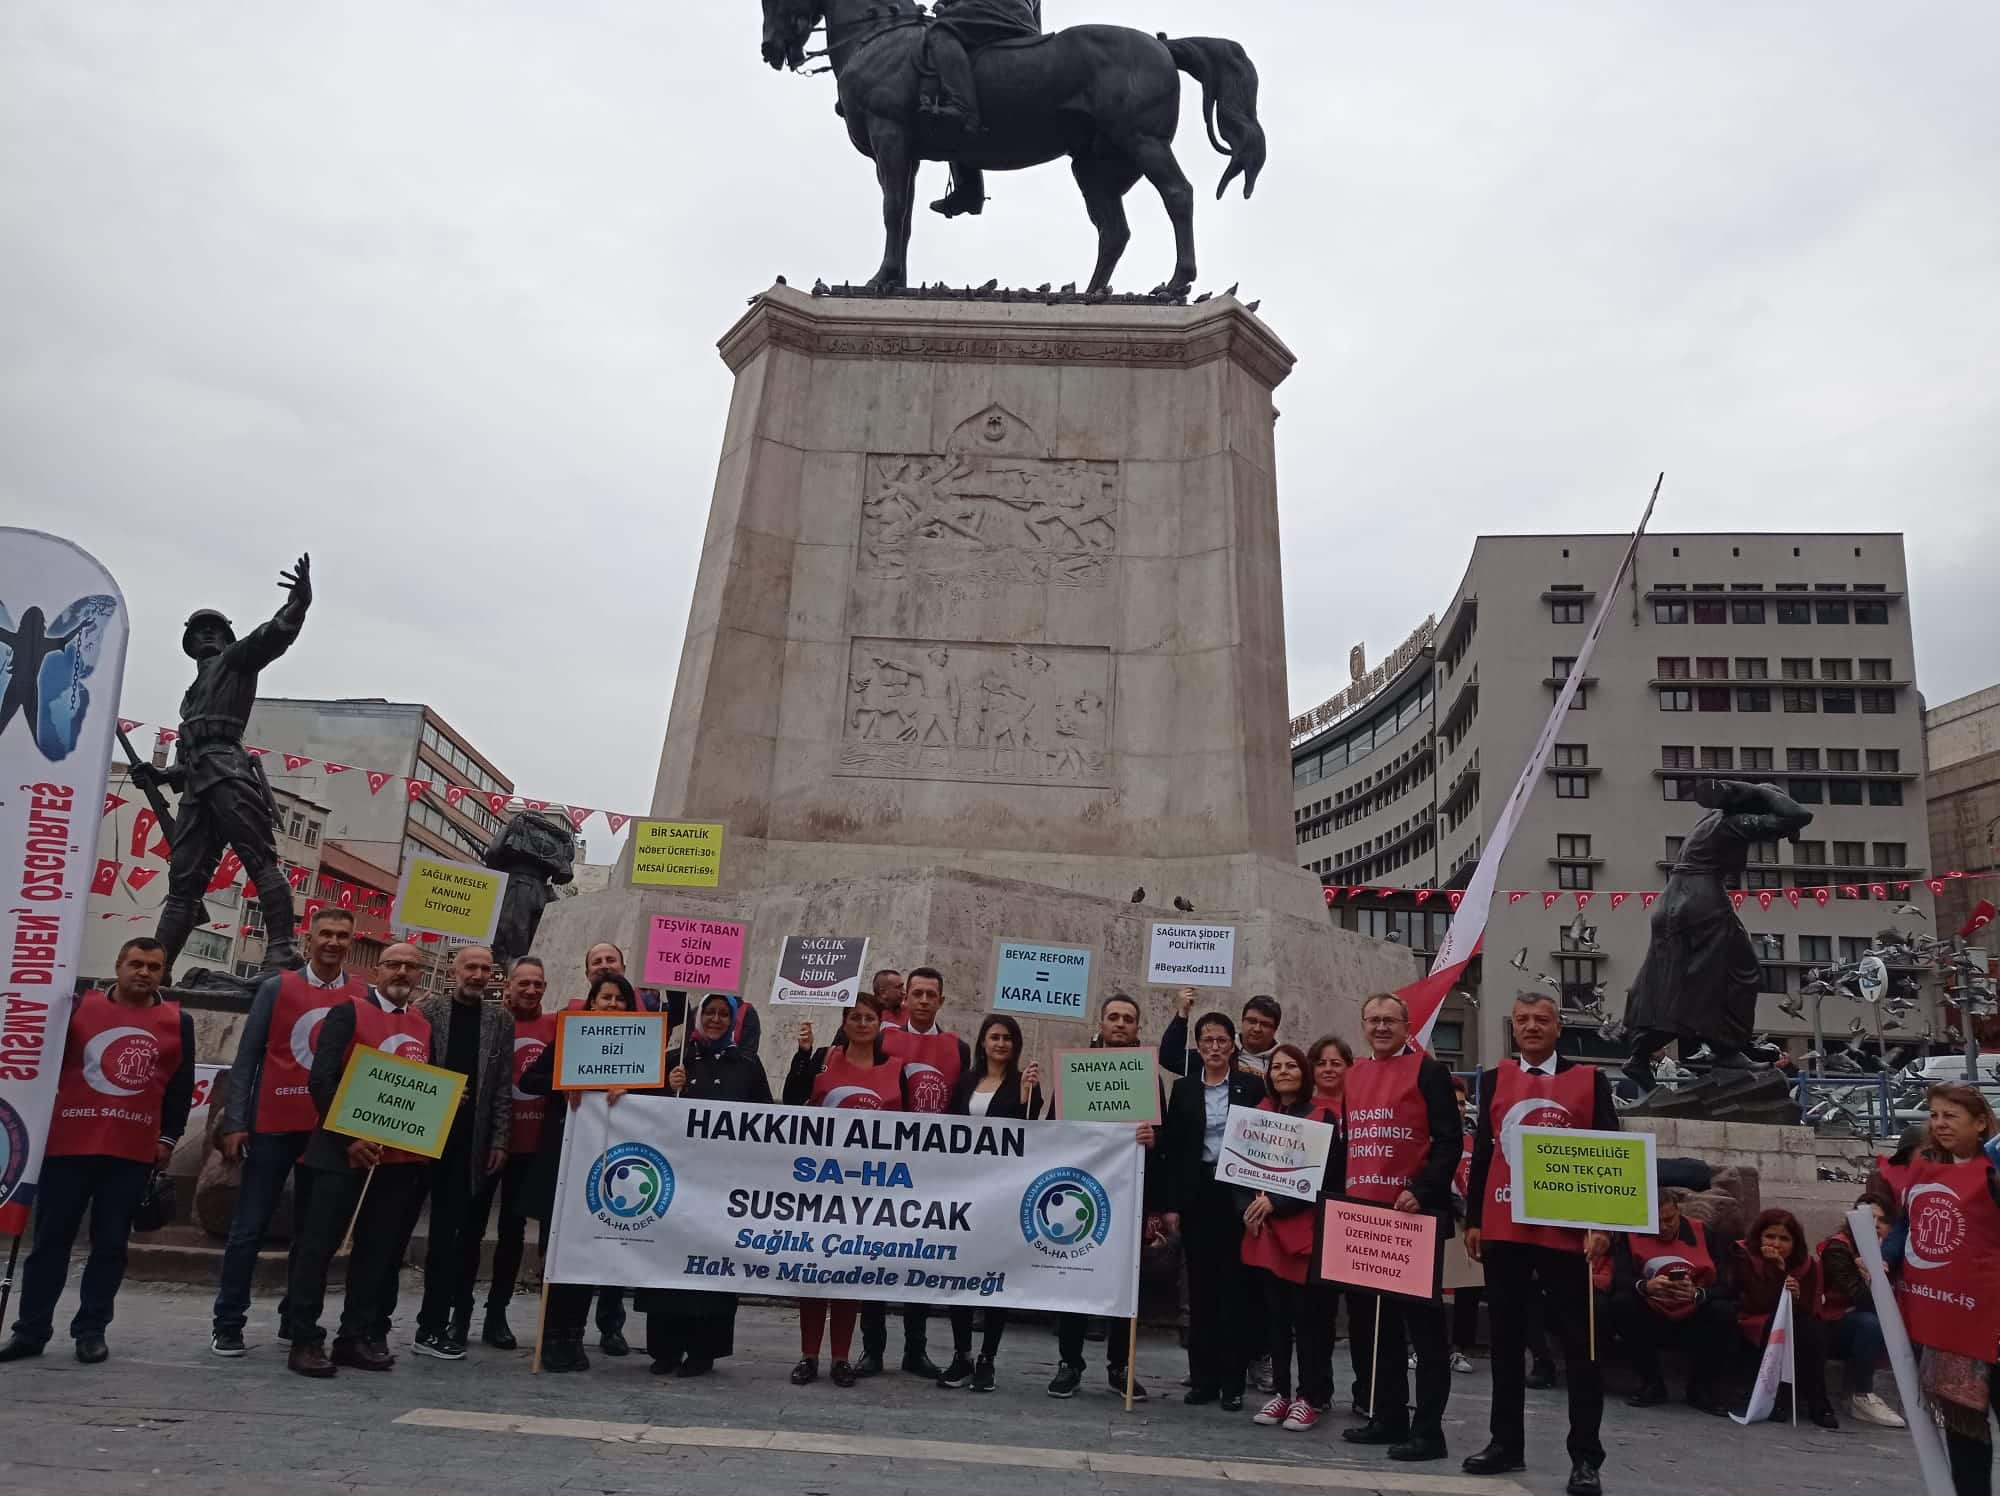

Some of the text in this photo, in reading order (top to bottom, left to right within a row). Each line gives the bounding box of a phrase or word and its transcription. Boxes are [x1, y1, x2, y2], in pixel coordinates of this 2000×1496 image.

[651, 826, 709, 839] BİR SAATLİK
[639, 845, 667, 855] NÖBET
[637, 863, 664, 873] MESAİ
[421, 868, 488, 890] SAĞLIK MESLEK
[431, 886, 471, 901] KANUNU
[425, 898, 472, 917] İSTİYORUZ
[656, 918, 740, 937] TEŞVİK TABAN
[1156, 926, 1230, 940] SAĞLIKTA ŞİDDET
[681, 936, 712, 951] SİZİN
[801, 937, 846, 950] SAĞLIK
[1169, 939, 1216, 951] POLİTİKTİR
[658, 951, 731, 969] TEK ÖDEME
[1005, 949, 1084, 967] BEYAZ REFORM
[673, 968, 711, 985] BİZİM
[800, 968, 837, 983] İŞİDİR.
[1154, 962, 1226, 976] #BeyazKod1111
[1001, 986, 1081, 1007] KARA LEKE
[581, 1024, 647, 1037] FAHRETTİN
[601, 1041, 624, 1056] BİZİ
[577, 1061, 645, 1076] KAHRETTİN
[1071, 1058, 1144, 1073] SAHAYA ACİL
[368, 1067, 438, 1096] ALKIŞLARLA
[1087, 1077, 1130, 1092] VE ADİL
[275, 1086, 311, 1096] GENEL
[377, 1092, 416, 1111] KARIN
[1088, 1100, 1131, 1112] ATAMA
[62, 1107, 97, 1118] GENEL
[1349, 1107, 1393, 1123] YAŞASIN
[352, 1108, 425, 1137] DOYMUYOR
[1259, 1119, 1297, 1133] MESLEK
[686, 1108, 1025, 1157] HAKKINI ALMADAN
[1242, 1129, 1306, 1152] ONURUMA
[1354, 1124, 1415, 1140] BAĞIMSIZ
[1247, 1148, 1295, 1166] DOKUNMA
[1536, 1141, 1630, 1160] SÖZLEŞMELİLİĞE
[793, 1157, 913, 1188] SA-HA
[1238, 1167, 1260, 1178] GENEL
[1262, 1172, 1288, 1185] SAĞLIK
[1546, 1163, 1622, 1179] SON TEK ÇATI
[1533, 1180, 1637, 1197] KADRO İSTİYORUZ
[727, 1189, 972, 1231] SUSMAYACAK
[632, 1215, 656, 1231] DER
[1337, 1210, 1423, 1233] YOKSULLUK SINIRI
[735, 1228, 957, 1261] Sağlık Çalışanları
[1345, 1228, 1413, 1248] ÜZERİNDE TEK
[1071, 1242, 1095, 1259] DER
[1345, 1244, 1410, 1264] KALEM MAAŞ
[683, 1255, 1006, 1296] Hak ve Mücadele Derneği
[1352, 1260, 1401, 1278] İSTİYORUZ
[1911, 1283, 1976, 1311] SAĞLIK-İŞ
